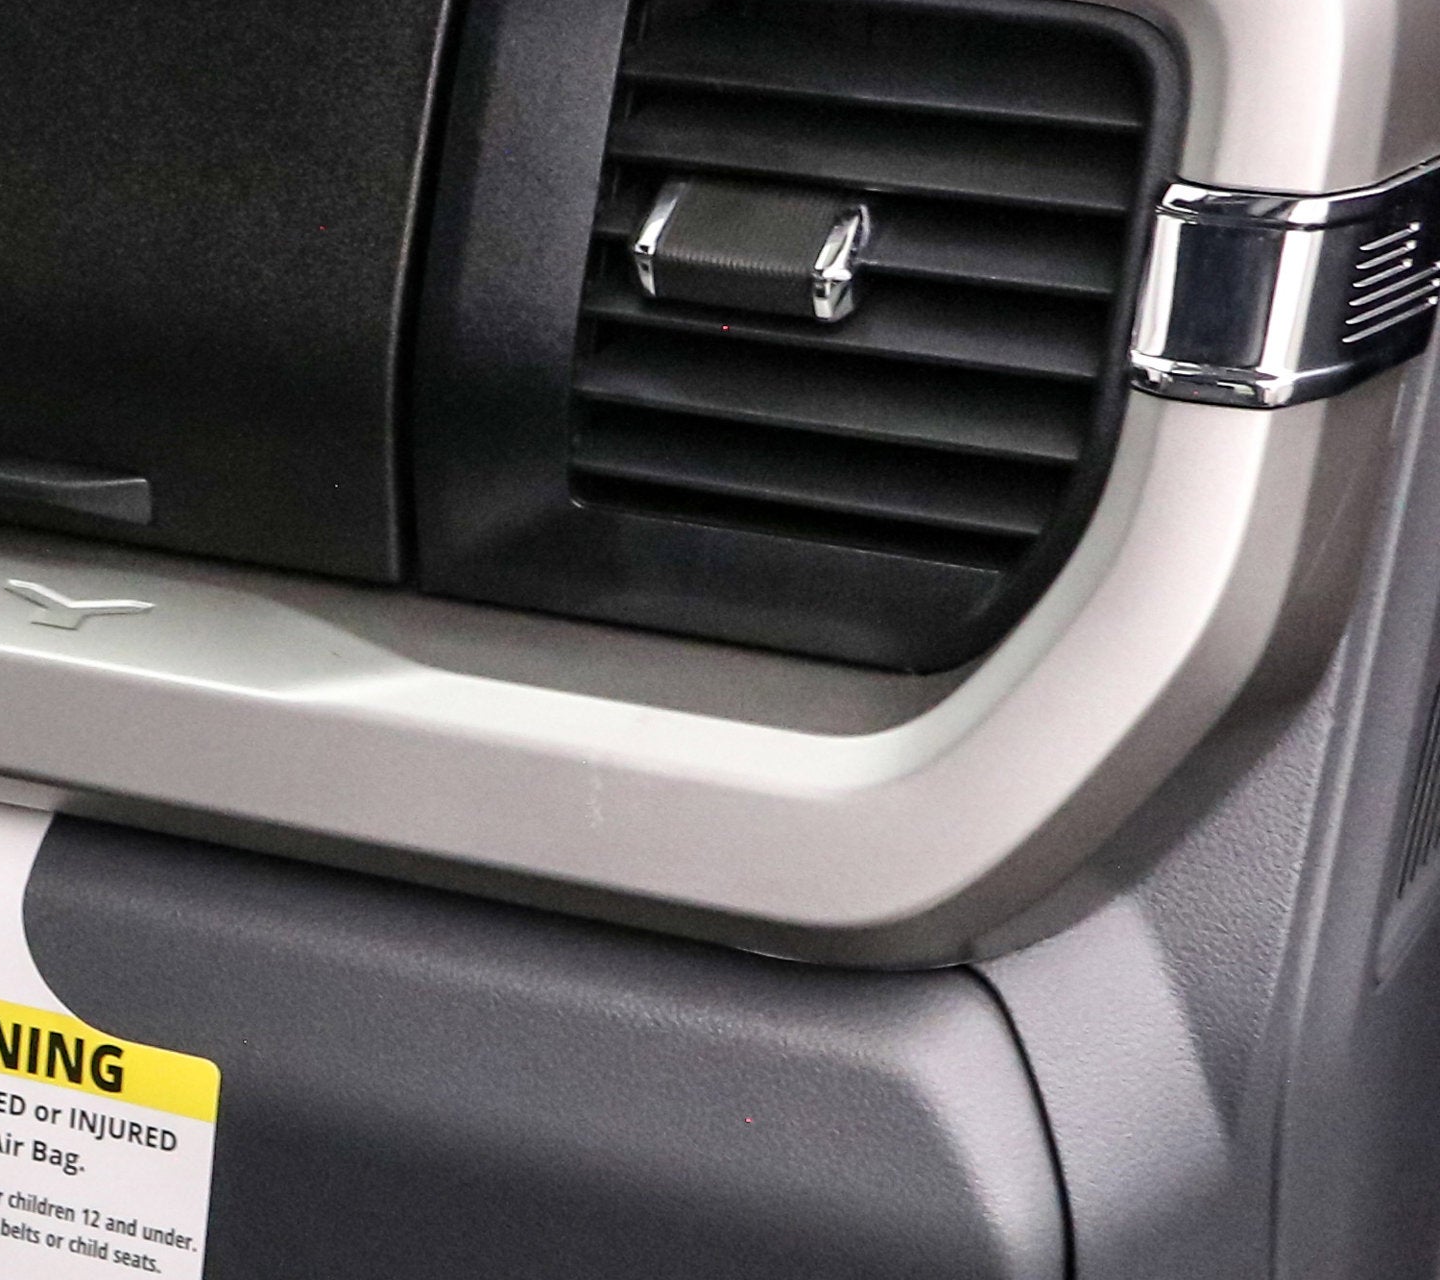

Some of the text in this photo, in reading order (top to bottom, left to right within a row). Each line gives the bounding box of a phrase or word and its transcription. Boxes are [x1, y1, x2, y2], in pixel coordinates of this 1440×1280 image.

[34, 1103, 63, 1125] or
[69, 1108, 178, 1152] INJURED
[32, 1140, 86, 1176] Bag.
[0, 1218, 41, 1244] belts
[45, 1231, 64, 1250] or
[69, 1236, 109, 1261] child
[112, 1248, 162, 1274] seats.
[8, 1190, 76, 1222] children
[82, 1208, 101, 1228] 12
[106, 1216, 137, 1238] and
[142, 1228, 198, 1253] under.
